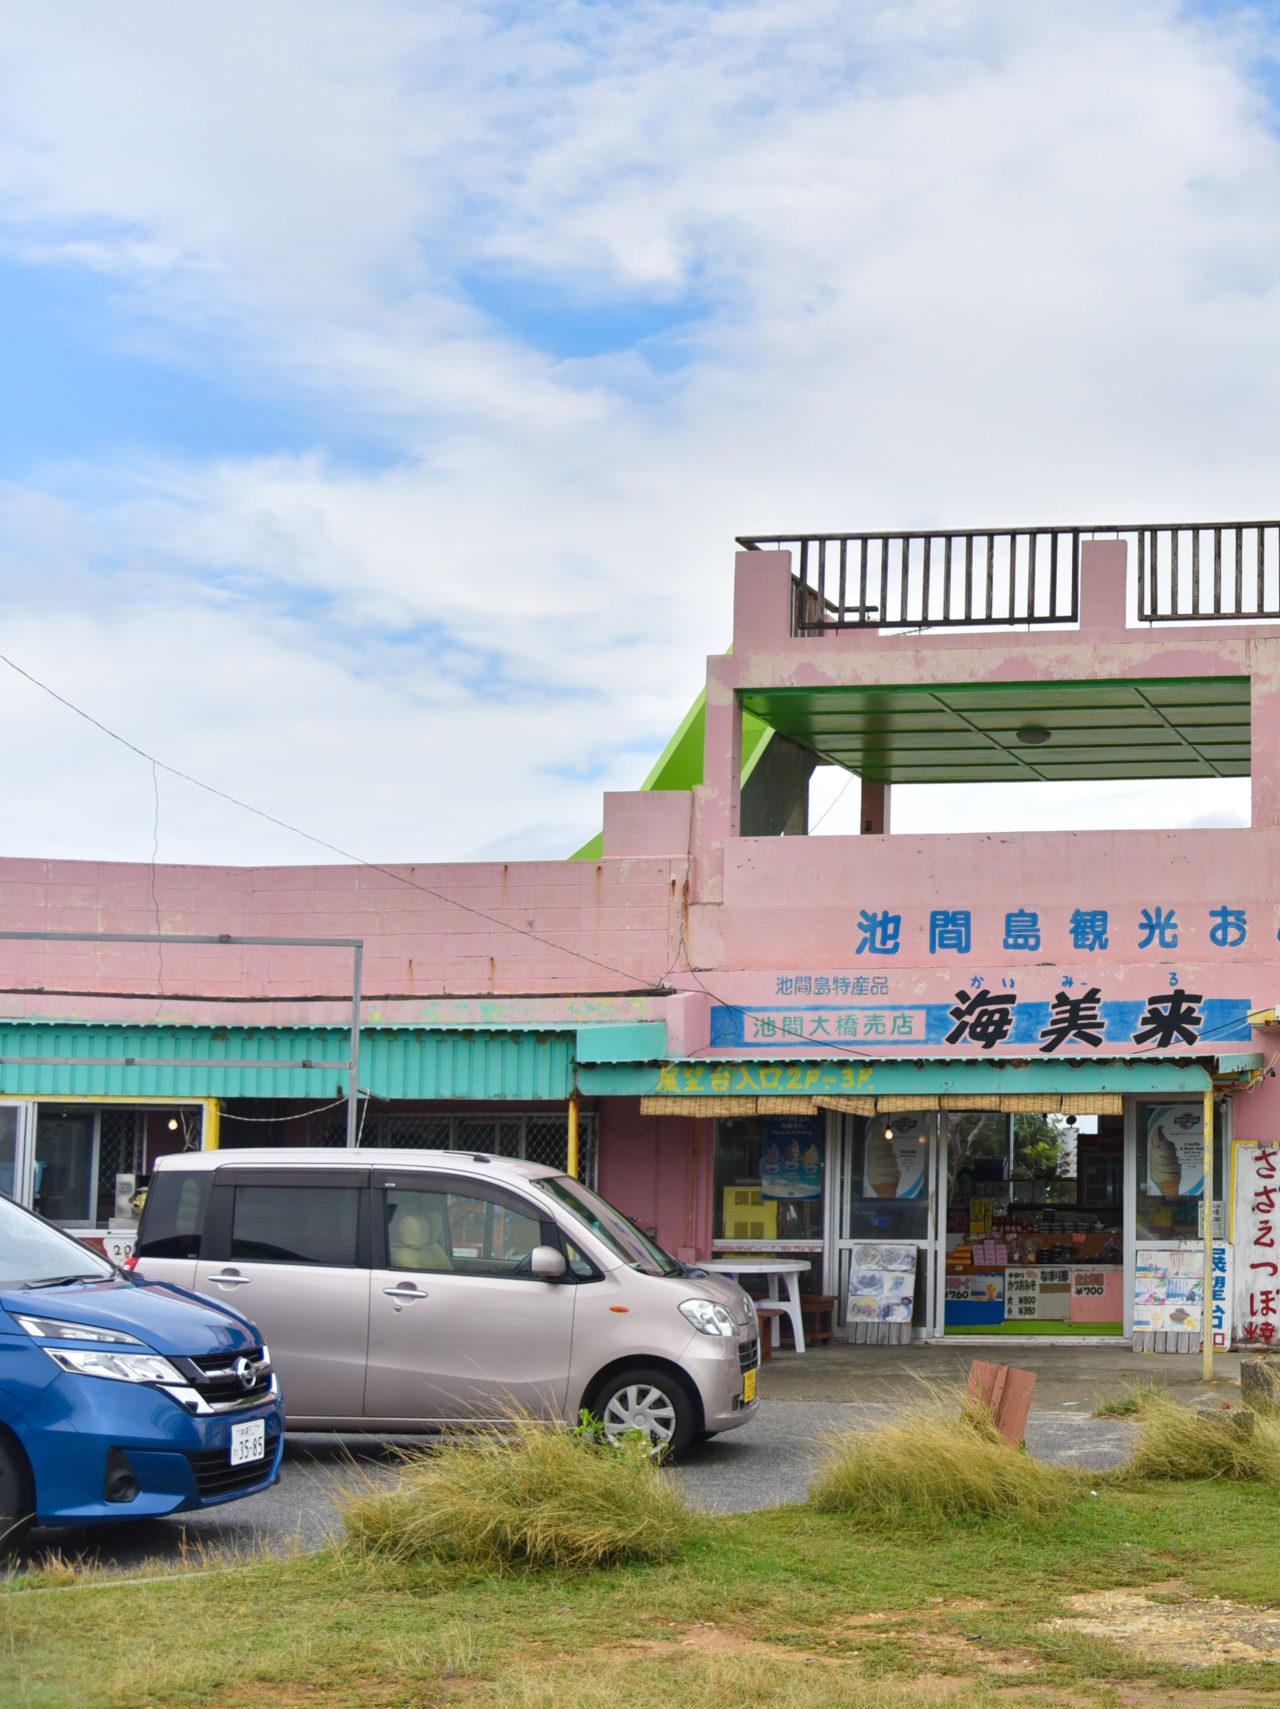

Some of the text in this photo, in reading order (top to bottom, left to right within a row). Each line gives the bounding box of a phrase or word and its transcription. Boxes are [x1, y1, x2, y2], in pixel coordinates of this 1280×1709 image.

[775, 975, 889, 996] 池間島特産品
[752, 1012, 914, 1040] 池間大橋売店
[945, 988, 1204, 1053] 海美来
[1074, 1286, 1104, 1296] ¥700
[239, 1436, 264, 1460] 35-85
